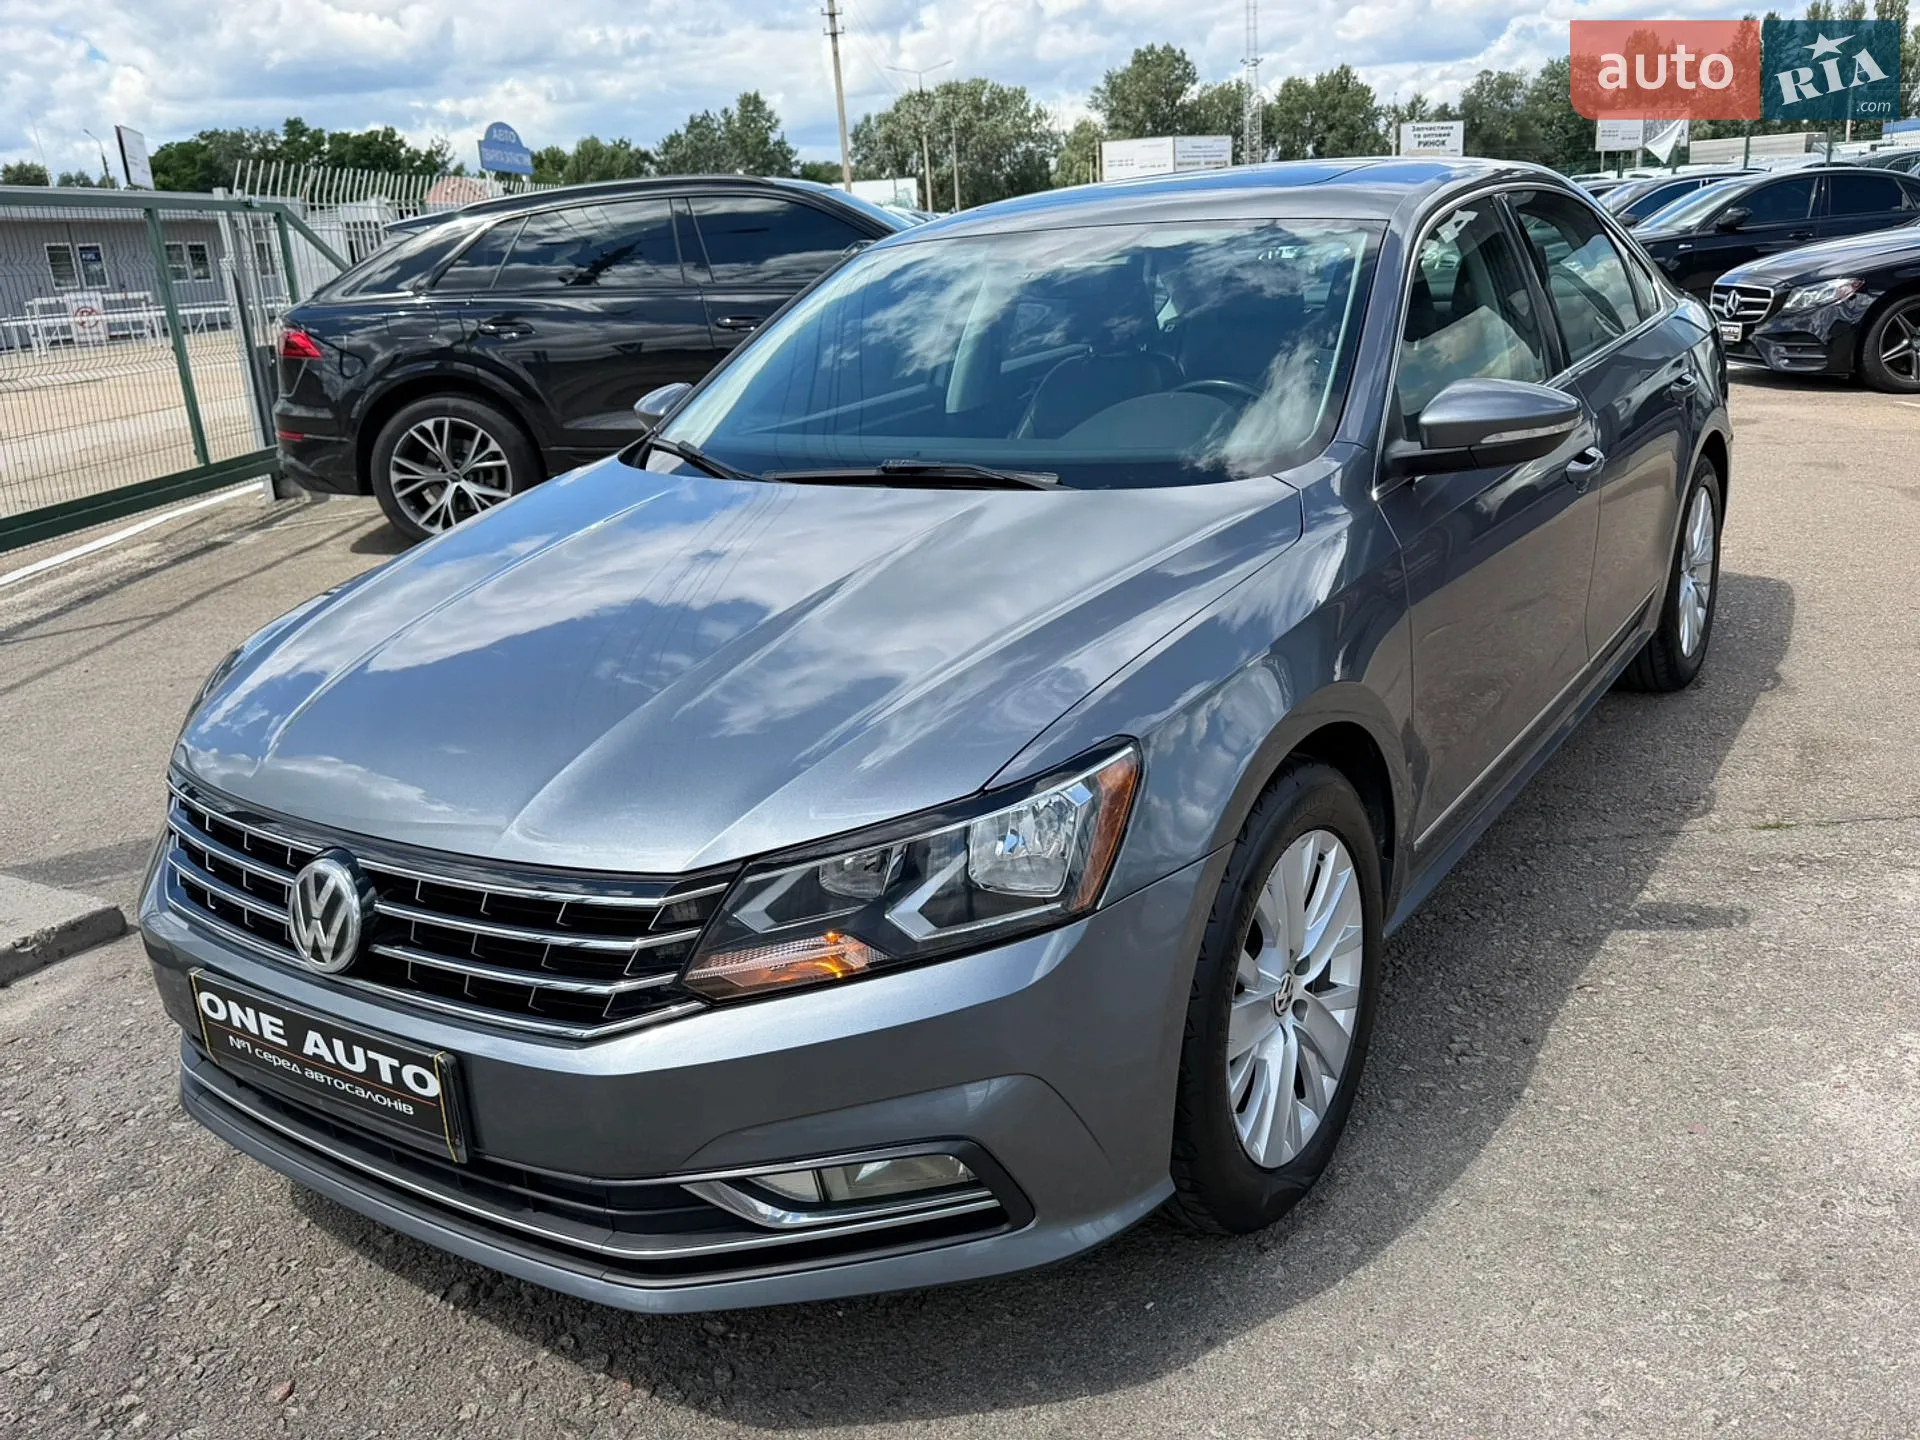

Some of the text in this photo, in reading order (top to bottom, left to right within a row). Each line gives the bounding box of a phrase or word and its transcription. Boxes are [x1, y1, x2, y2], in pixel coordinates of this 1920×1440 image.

[1417, 139, 1447, 148] РИНОК
[199, 991, 440, 1097] ONE AUTO
[229, 1034, 415, 1115] №1 серед автосалонів
